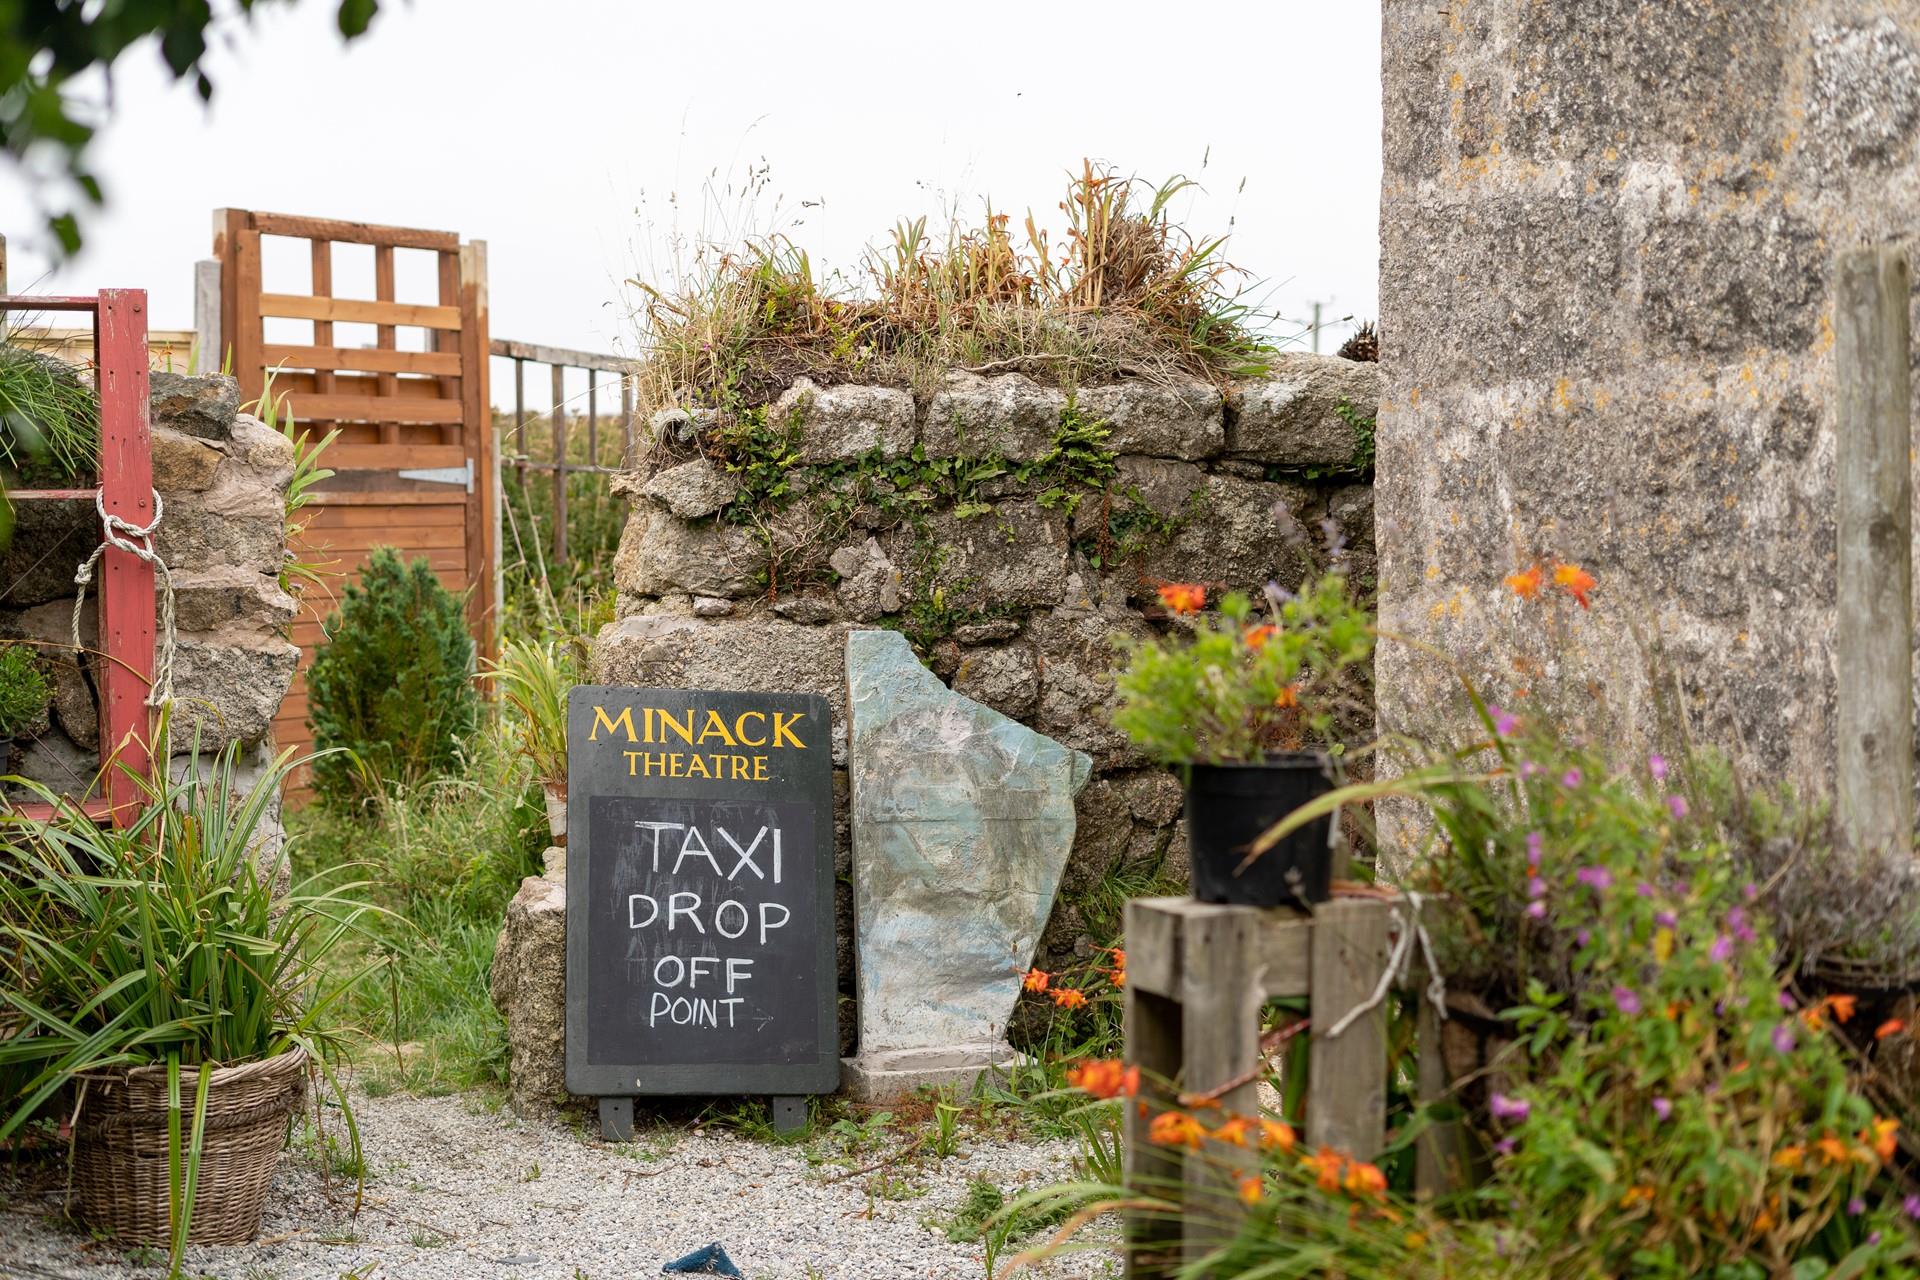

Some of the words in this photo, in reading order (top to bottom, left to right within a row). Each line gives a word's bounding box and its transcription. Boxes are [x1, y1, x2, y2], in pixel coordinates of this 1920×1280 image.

[589, 706, 807, 749] MINACK
[623, 750, 769, 781] THEATRE
[635, 820, 782, 883] TAXI
[628, 892, 790, 945] DROP
[654, 955, 754, 995] OFF
[650, 991, 745, 1028] POINT
